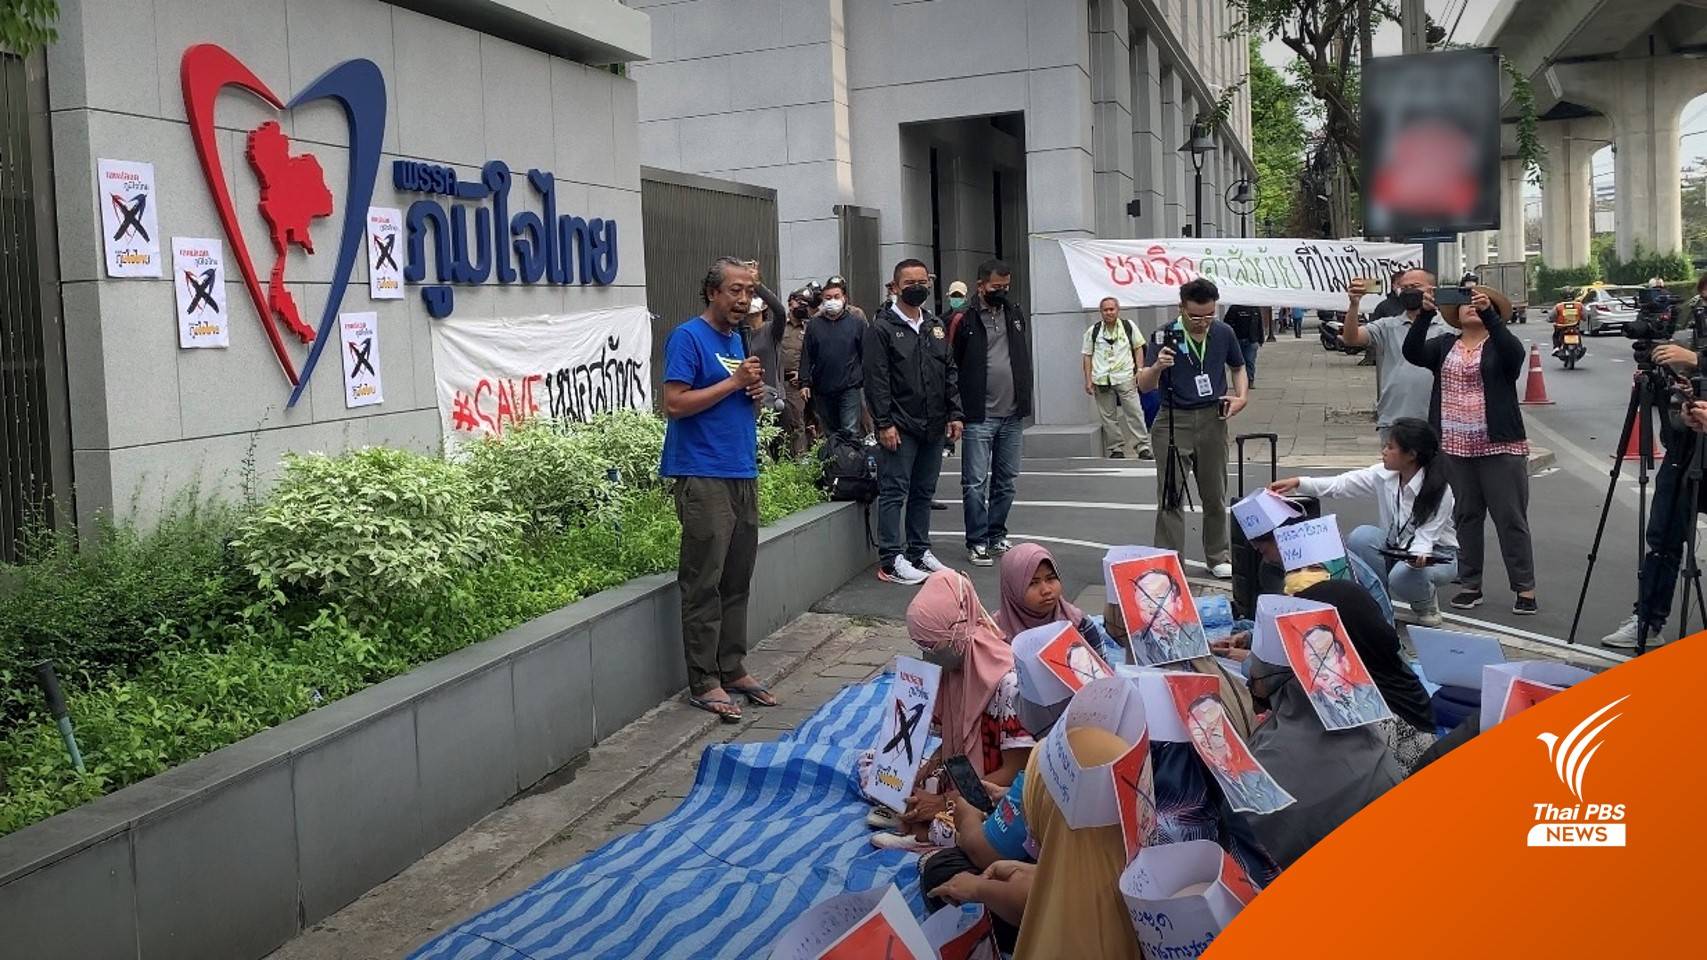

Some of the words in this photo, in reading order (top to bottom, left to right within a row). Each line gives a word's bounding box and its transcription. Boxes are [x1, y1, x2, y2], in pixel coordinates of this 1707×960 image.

[393, 160, 457, 196] พรรค
[404, 160, 618, 319] ภูมิใจไทย
